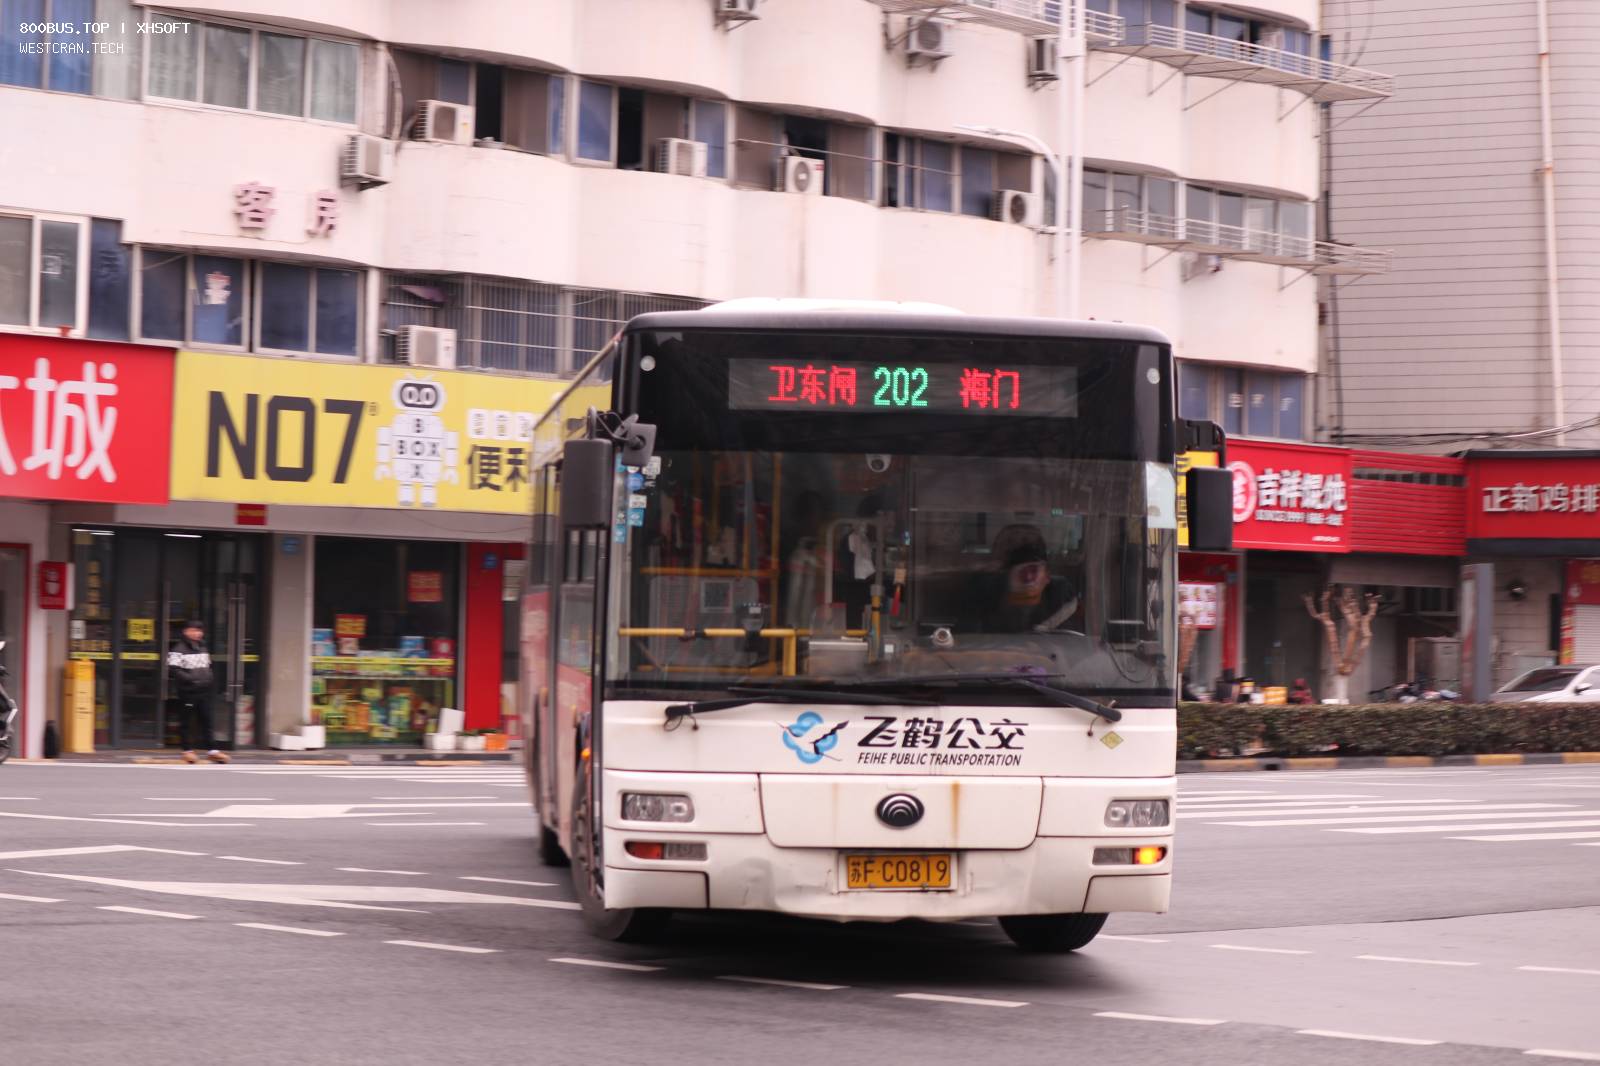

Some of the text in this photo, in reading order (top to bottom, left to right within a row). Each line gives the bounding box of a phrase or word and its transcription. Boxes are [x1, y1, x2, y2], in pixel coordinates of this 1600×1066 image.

[768, 364, 1020, 409] 卫东闸 202 海门
[206, 390, 366, 484] NO7
[397, 439, 440, 458] BOX
[1482, 482, 1600, 513] 正新鸡排
[857, 716, 1029, 750] 飞鹤公交
[857, 752, 1022, 766] FEIHE PUBLIC TRANSPORTATION
